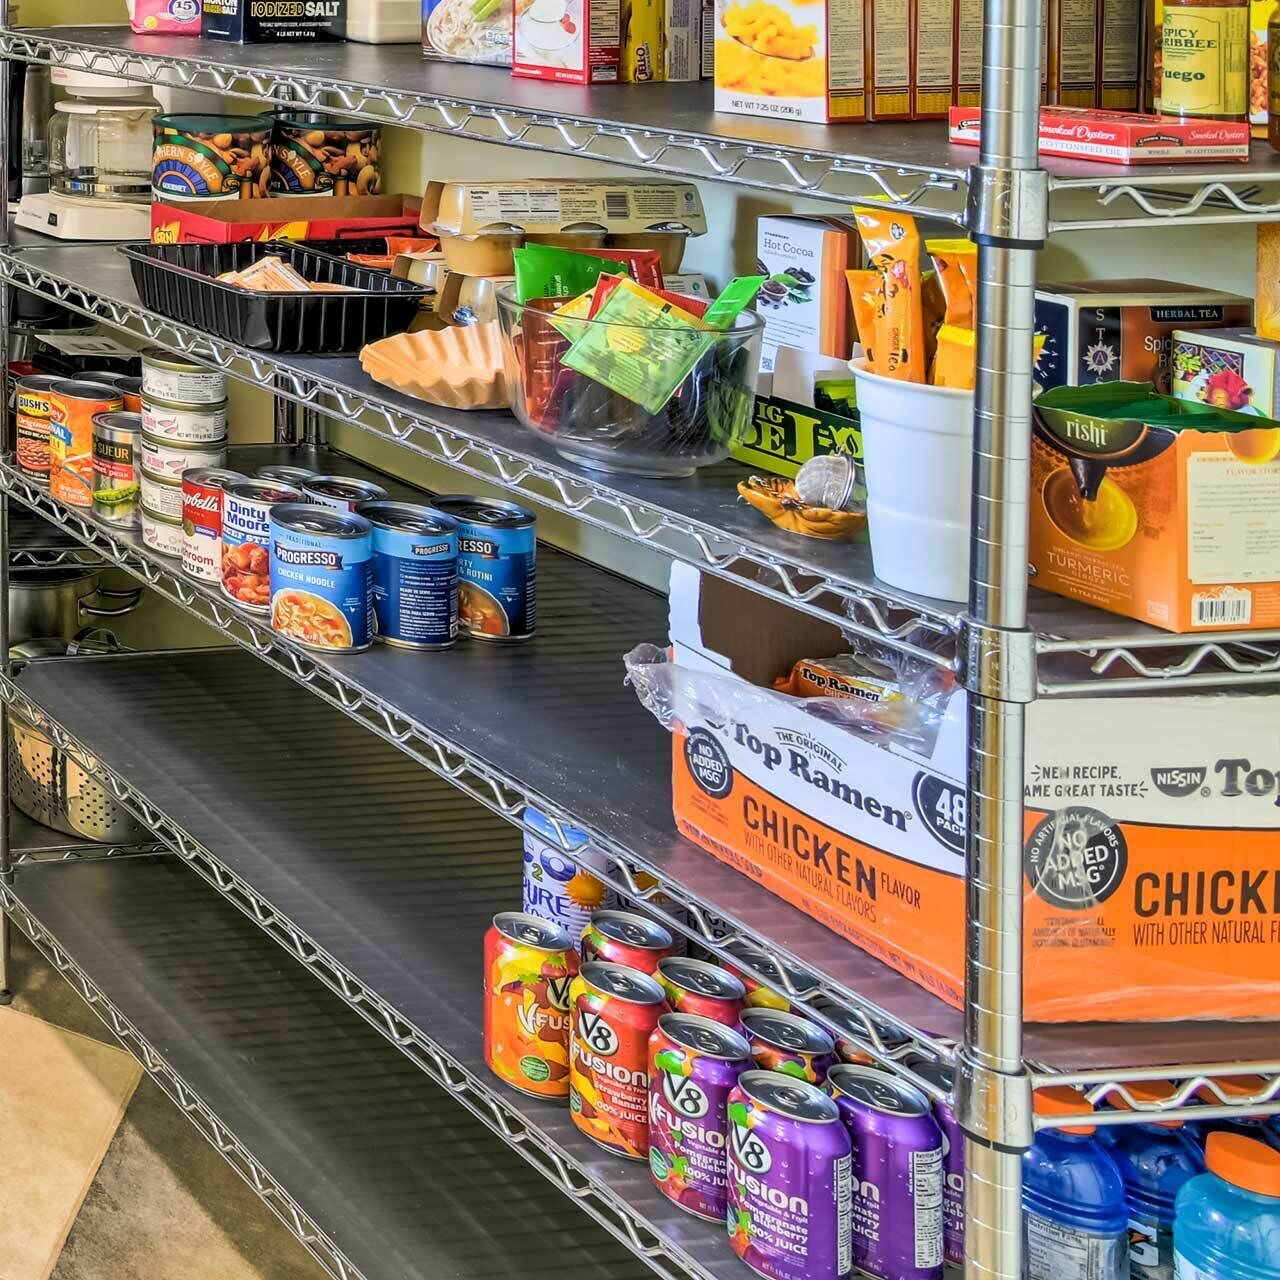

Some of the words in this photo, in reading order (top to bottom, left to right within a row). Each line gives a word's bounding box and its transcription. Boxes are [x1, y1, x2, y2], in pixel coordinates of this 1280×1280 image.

[222, 4, 238, 16] SALT
[251, 2, 304, 17] IODIZED
[305, 2, 339, 16] SALT
[1164, 28, 1198, 39] SPICY
[732, 100, 743, 108] NET
[1078, 125, 1115, 141] Oysters
[1191, 130, 1219, 140] Smoked
[1221, 130, 1246, 140] Oysters
[764, 239, 781, 250] Hot
[783, 244, 814, 258] Cocoa
[1157, 308, 1196, 319] HERBAL
[1199, 308, 1218, 318] TEA
[19, 396, 49, 412] BUSH'S
[1067, 418, 1106, 446] rishi
[229, 500, 266, 521] Dinty
[227, 511, 269, 532] Moore
[277, 548, 336, 565] PROGRESSO
[415, 545, 448, 555] PROGRESSO
[278, 569, 304, 581] CHICKEN
[306, 577, 335, 588] NOODLE
[467, 569, 492, 581] ROTINI
[1047, 552, 1130, 587] TURMERIC
[802, 668, 825, 686] Top
[828, 676, 880, 703] Ramen
[699, 744, 712, 757] NO
[776, 732, 794, 744] THE
[797, 735, 842, 770] ORIGINAL
[693, 754, 722, 772] ADDED
[700, 767, 720, 783] MSG
[734, 722, 785, 771] Top
[790, 749, 908, 832] Ramen
[1156, 770, 1201, 787] NISSIN
[1054, 784, 1095, 798] GREAT
[1099, 784, 1137, 797] TASTE
[743, 795, 876, 901] CHICKEN
[881, 873, 921, 908] FLAVOR
[744, 831, 765, 856] WITH
[768, 844, 792, 871] OTHER
[796, 861, 833, 898] NATURAL
[836, 886, 876, 922] FLAVORS
[1134, 924, 1165, 946] WITH
[1169, 923, 1207, 945] OTHER
[1212, 920, 1264, 944] NATURAL
[579, 1009, 610, 1051] V8
[594, 1081, 647, 1105] Strawberry
[664, 1069, 701, 1114] V8
[612, 1097, 647, 1111] Banana
[620, 1111, 647, 1123] JUICE
[733, 1125, 764, 1169] V8
[740, 1195, 808, 1234] Pomegranate
[747, 1221, 773, 1243] 100%
[776, 1237, 807, 1256] JUICE
[754, 1214, 808, 1244] Blueberry
